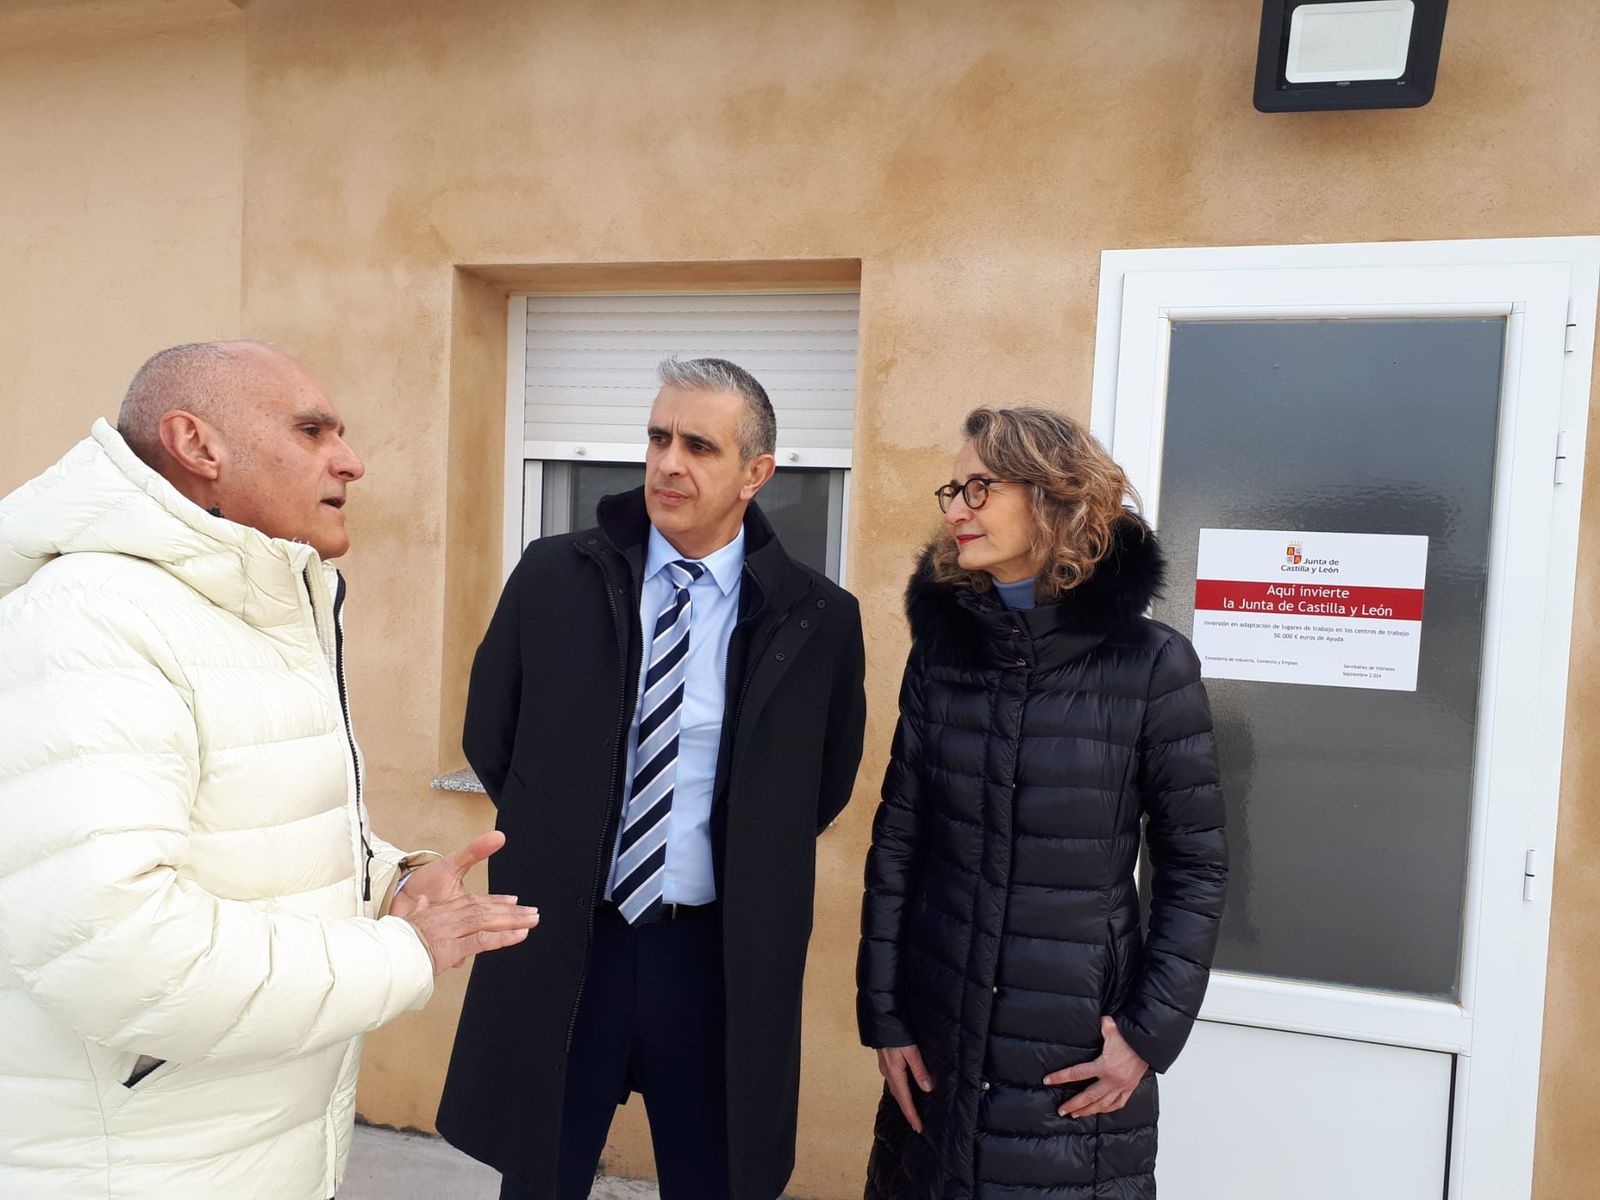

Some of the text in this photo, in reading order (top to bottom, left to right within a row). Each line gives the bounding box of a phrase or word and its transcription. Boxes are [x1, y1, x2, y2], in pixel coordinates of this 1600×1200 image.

[1304, 557, 1339, 566] Junta de
[1281, 564, 1310, 573] Castilla
[1318, 566, 1339, 574] León
[1266, 584, 1350, 599] Aquí invierte
[1224, 597, 1393, 617] la Junta de Castilla y León
